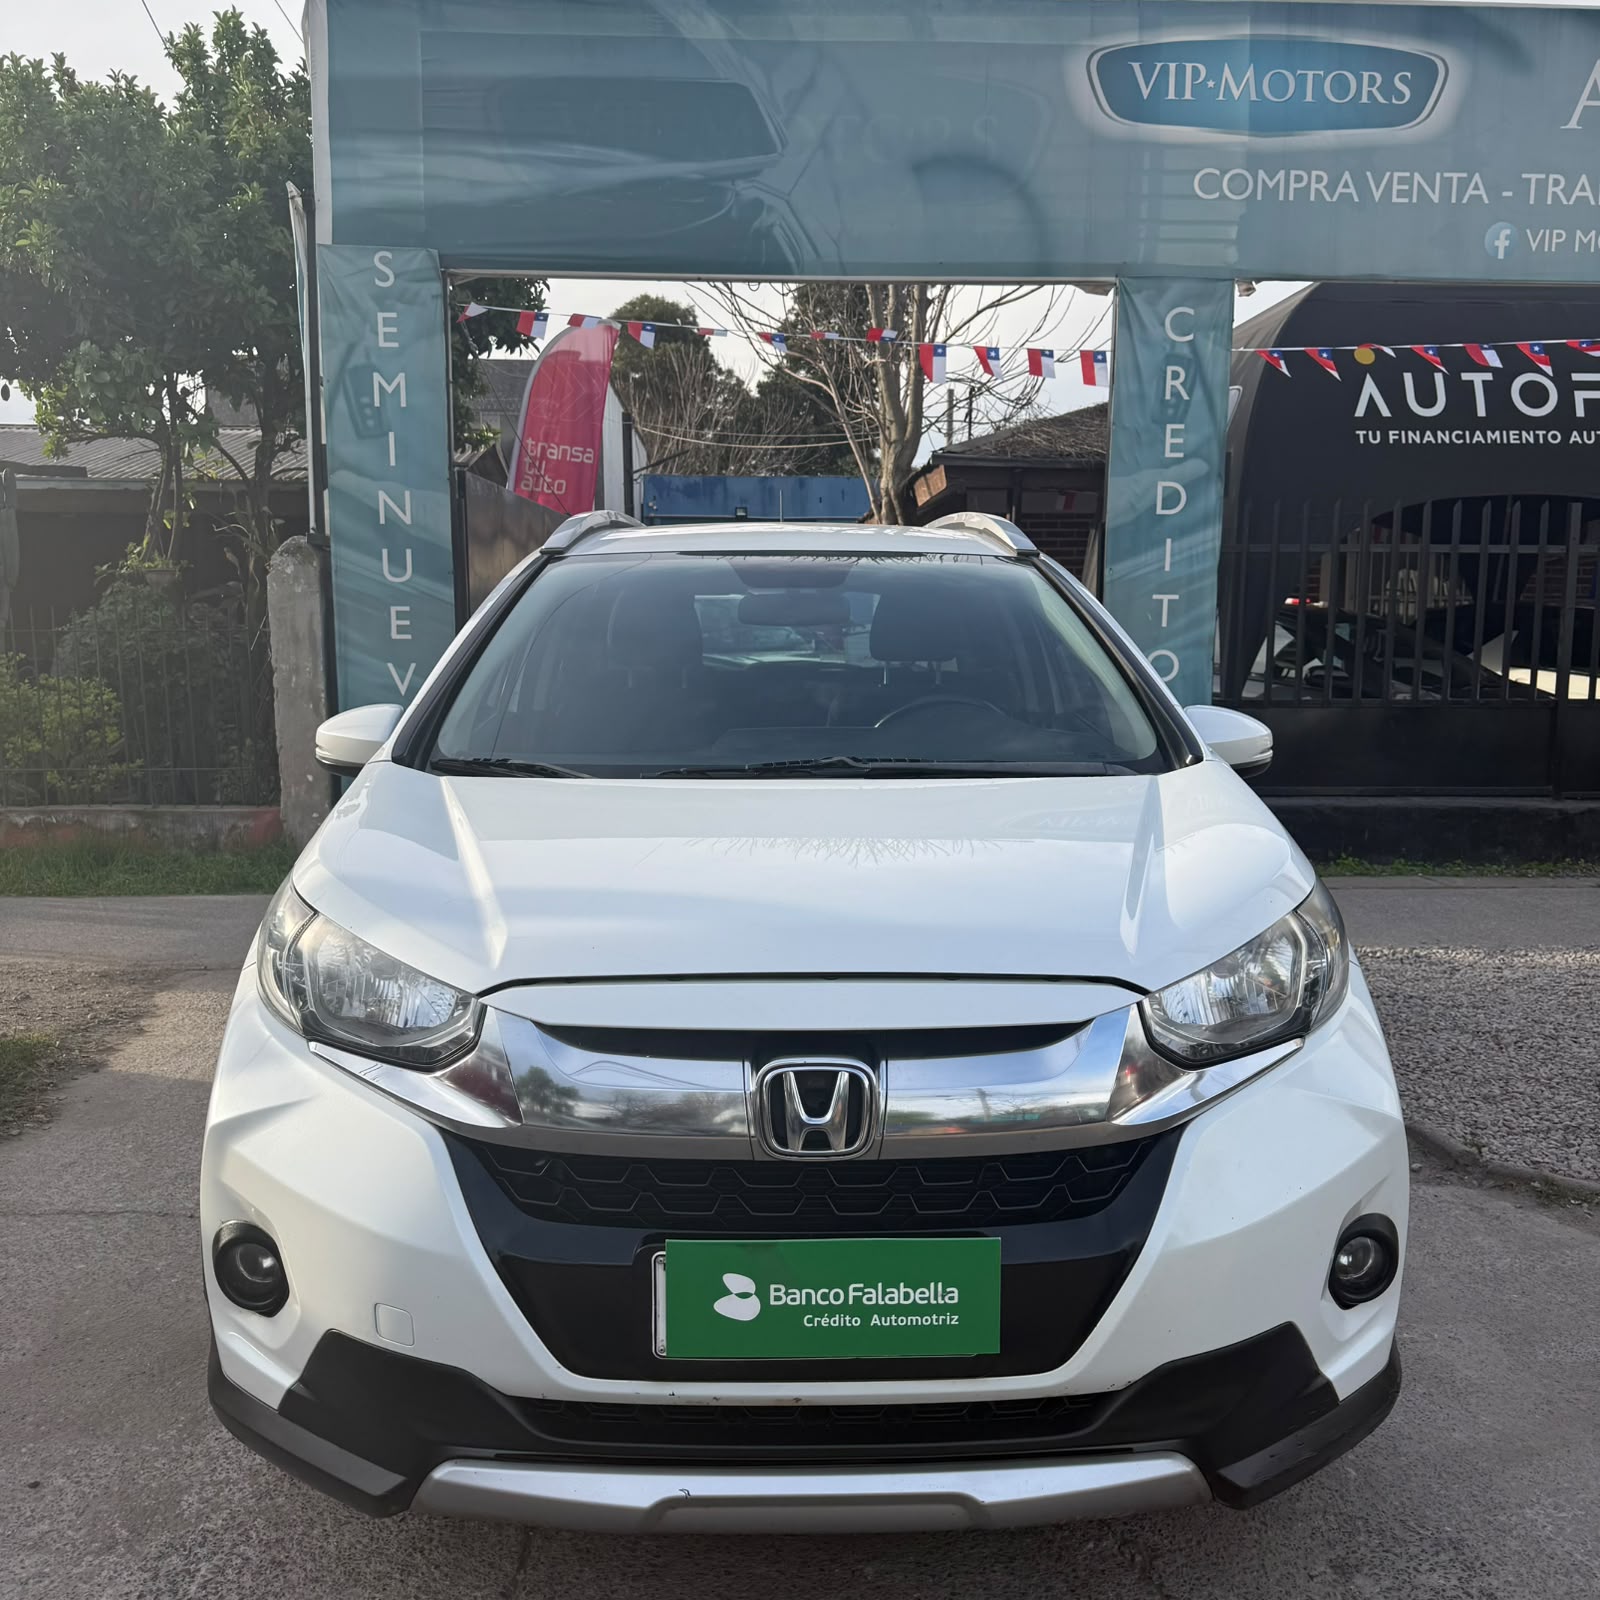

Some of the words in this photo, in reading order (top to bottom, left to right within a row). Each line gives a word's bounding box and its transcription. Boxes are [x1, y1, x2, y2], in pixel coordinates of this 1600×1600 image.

[1128, 61, 1207, 101] VIP
[1215, 62, 1412, 105] MOTORS
[1193, 167, 1360, 203] COMPRA
[1366, 171, 1489, 205] VENTA
[1521, 173, 1600, 206] TRA
[1525, 229, 1567, 252] VIP
[1574, 229, 1600, 253] M
[1356, 430, 1381, 444] TU
[1389, 429, 1562, 445] FINANCIAMIENTO
[526, 437, 595, 464] transa
[524, 457, 546, 475] tu
[520, 474, 567, 495] auto
[1146, 306, 1196, 683] CREDITO
[769, 1284, 845, 1306] Banco
[848, 1281, 959, 1305] Falabella
[803, 1313, 861, 1328] Crédito
[870, 1312, 959, 1327] Automotriz
